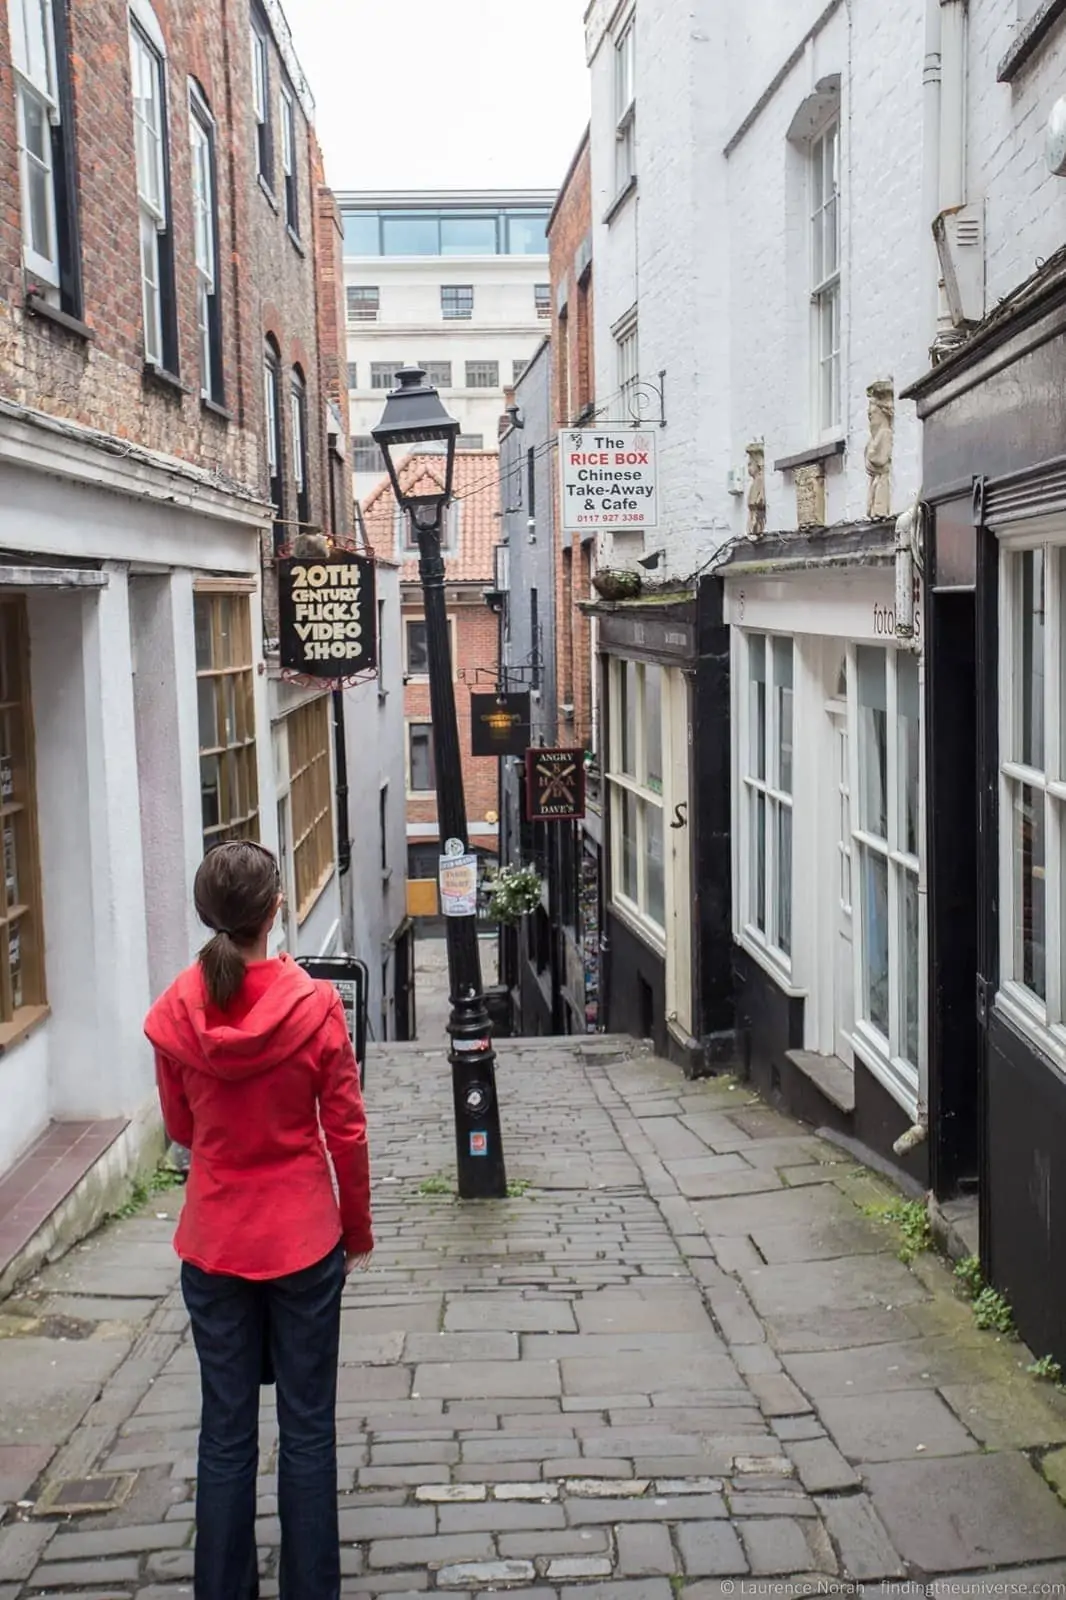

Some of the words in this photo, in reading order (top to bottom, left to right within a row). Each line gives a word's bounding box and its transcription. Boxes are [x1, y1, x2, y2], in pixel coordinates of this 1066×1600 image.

[594, 437, 625, 449] The
[571, 453, 609, 465] RICE
[615, 452, 649, 465] BOX
[578, 469, 642, 481] Chinese
[566, 484, 654, 497] Take-Away
[584, 499, 595, 510] &
[602, 498, 638, 510] Cafe
[602, 514, 619, 522] 927
[290, 564, 361, 587] 20TH
[291, 588, 361, 602] CENTURY
[295, 602, 361, 621] FLICKS
[293, 622, 362, 641] VIDEO
[303, 641, 363, 660] SHOP
[540, 753, 574, 762] ANGRY
[540, 804, 574, 814] DAVE'S
